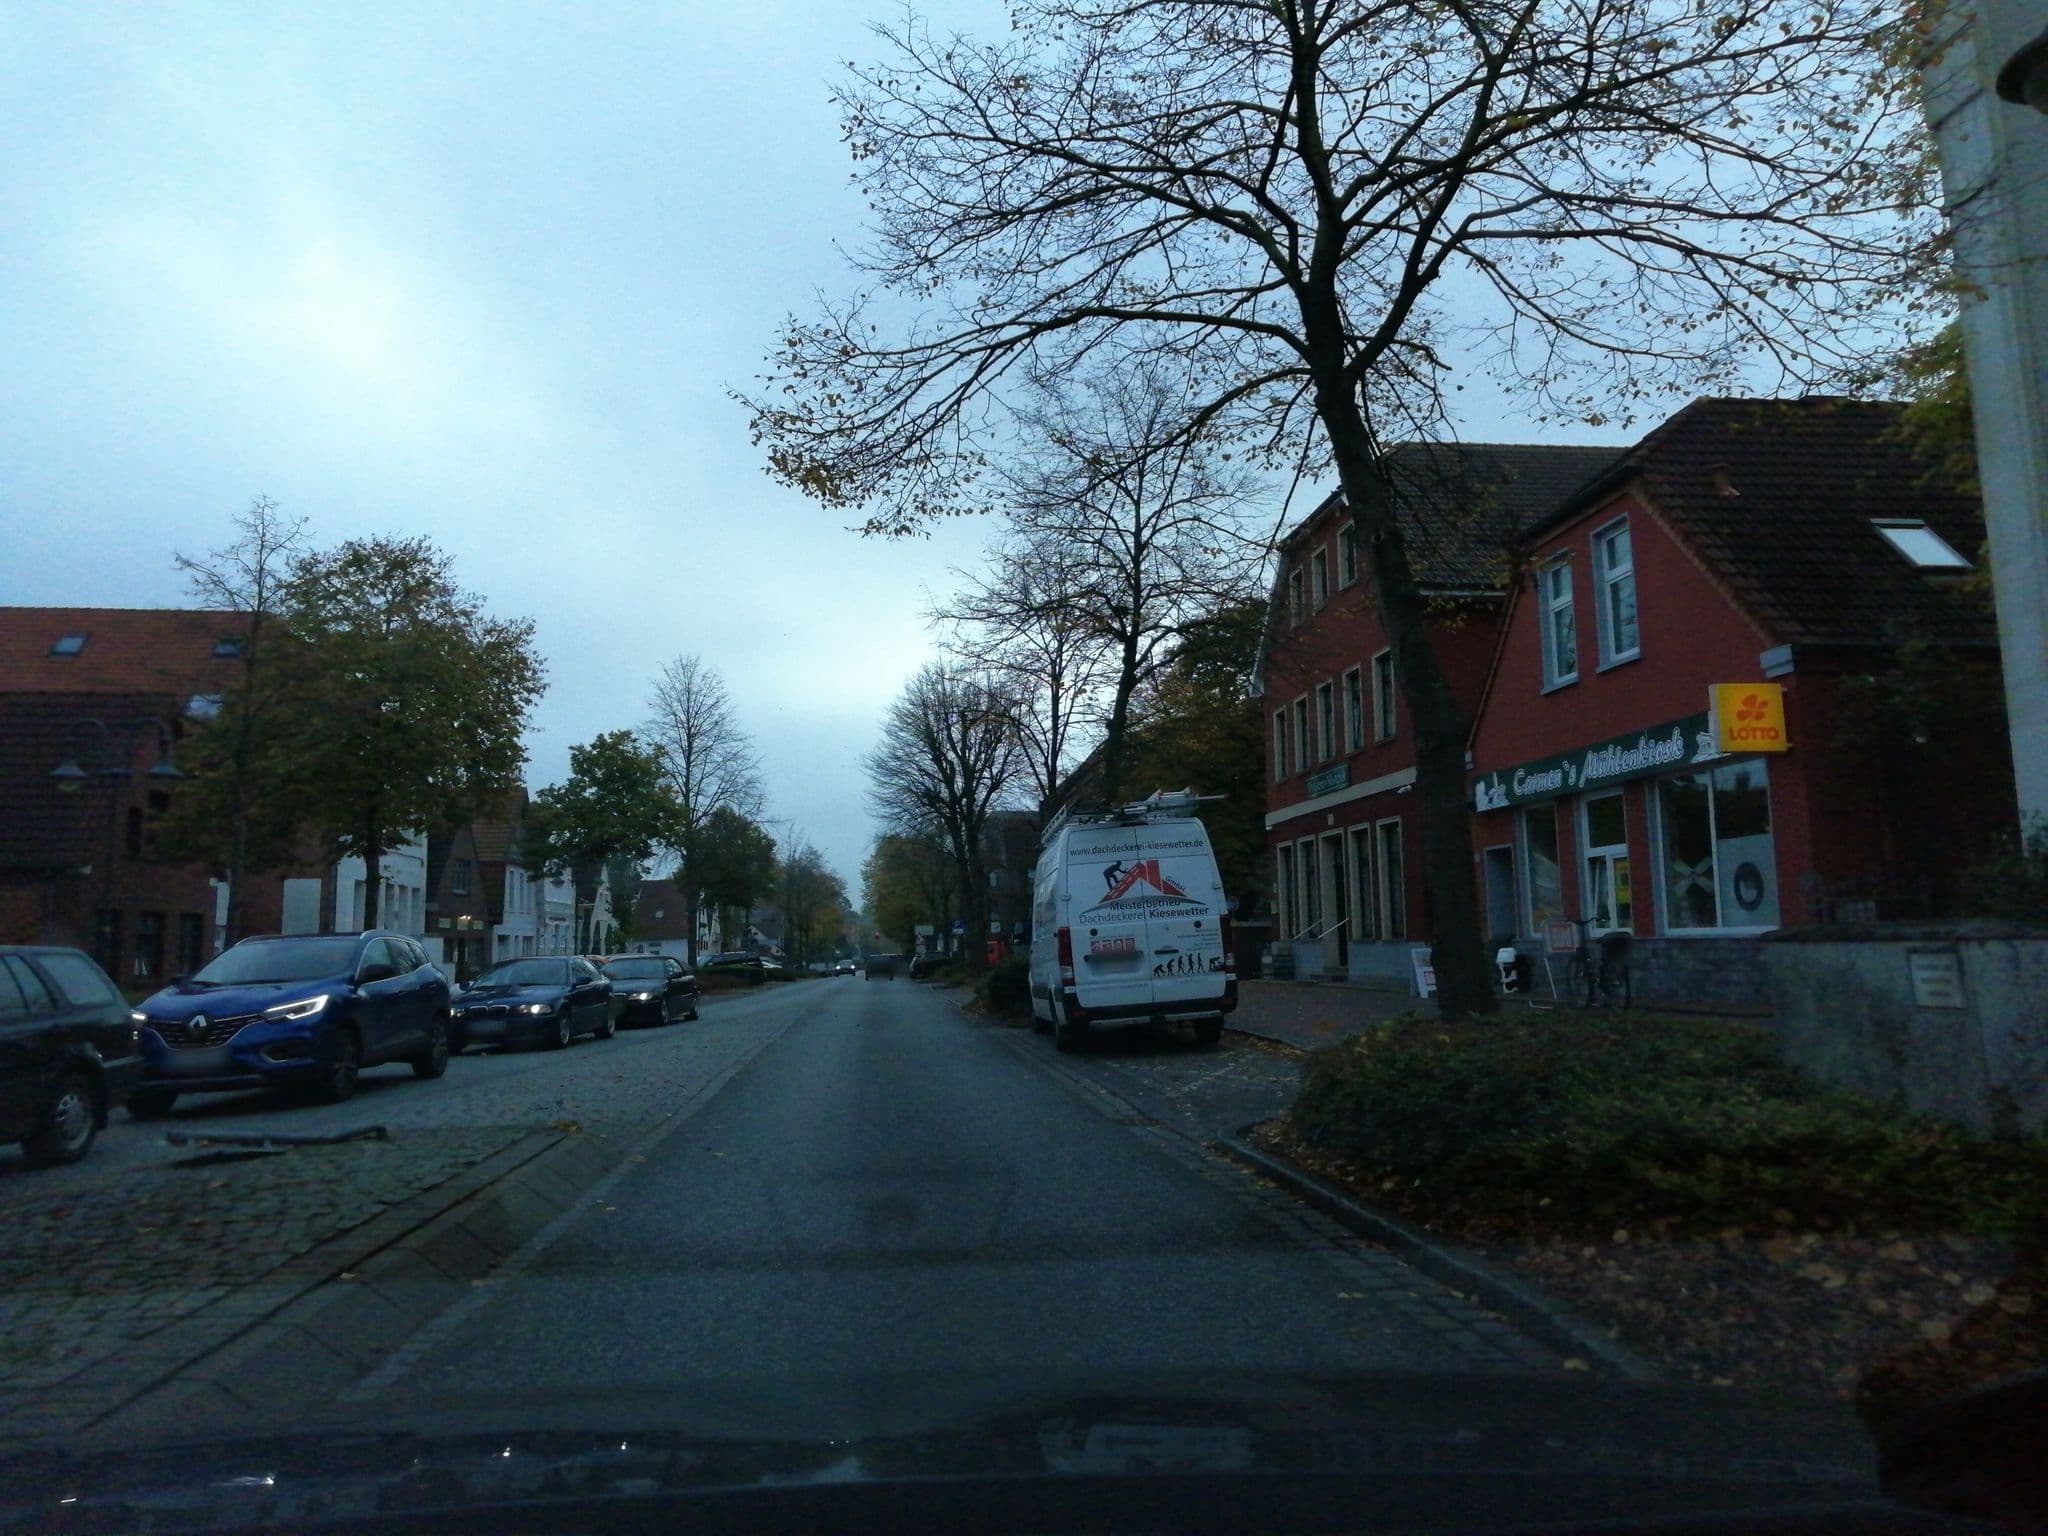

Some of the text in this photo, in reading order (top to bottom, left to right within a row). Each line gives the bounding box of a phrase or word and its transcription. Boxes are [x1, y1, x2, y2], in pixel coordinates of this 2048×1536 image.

[1729, 727, 1779, 740] LOTTO
[1579, 726, 1685, 788] Mühlenkiosk
[1070, 840, 1204, 856] www.dachdeckerei-kiesewetter.de
[1110, 899, 1180, 911] Meisterbetrieb
[1079, 907, 1209, 924] Dachdeckerei Kiesewetter
